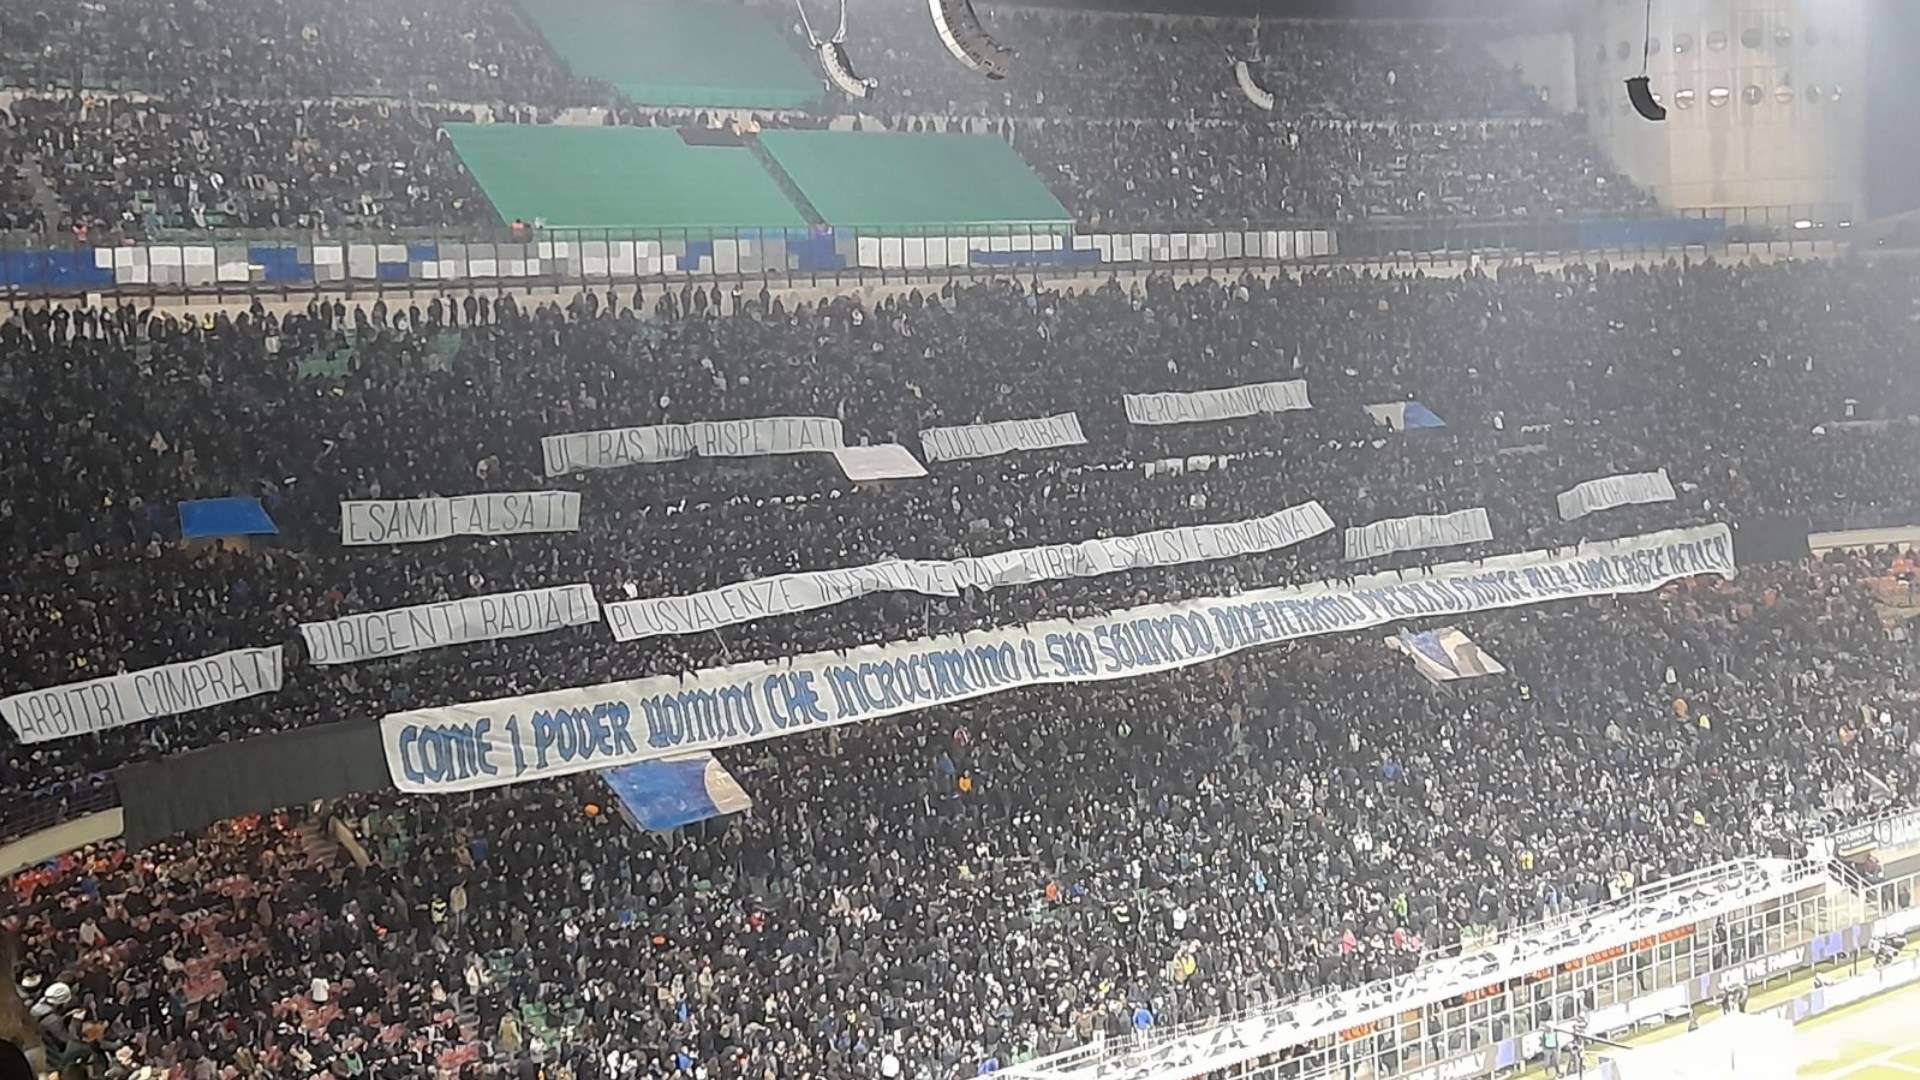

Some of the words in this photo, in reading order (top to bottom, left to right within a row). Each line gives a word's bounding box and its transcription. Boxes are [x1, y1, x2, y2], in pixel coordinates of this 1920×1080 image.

[548, 430, 645, 473] ULTRAS
[654, 422, 699, 458] NON
[704, 418, 840, 455] RISPETTATI
[921, 423, 1014, 460] SCUDETTI
[1013, 412, 1086, 449] RUBATI
[348, 499, 438, 542] ESAMI
[450, 492, 567, 534] FALSATI
[611, 577, 805, 638] PLUSVALENZE
[812, 560, 957, 603] INVENTATE
[1101, 529, 1188, 570] ESPULSI
[1192, 527, 1205, 558] E
[1213, 504, 1326, 558] CONDANNATI
[307, 601, 469, 662] DIRIGENTI
[480, 586, 590, 636] RADIATI
[14, 684, 126, 738] ARBITRI
[134, 650, 279, 715] COMPRATI
[399, 717, 498, 785] COME
[640, 681, 763, 749] UOMINI
[763, 670, 829, 729] CHE
[823, 640, 1023, 719] INCROCIARONO
[1020, 638, 1049, 681] IL
[1045, 631, 1098, 678] SUO
